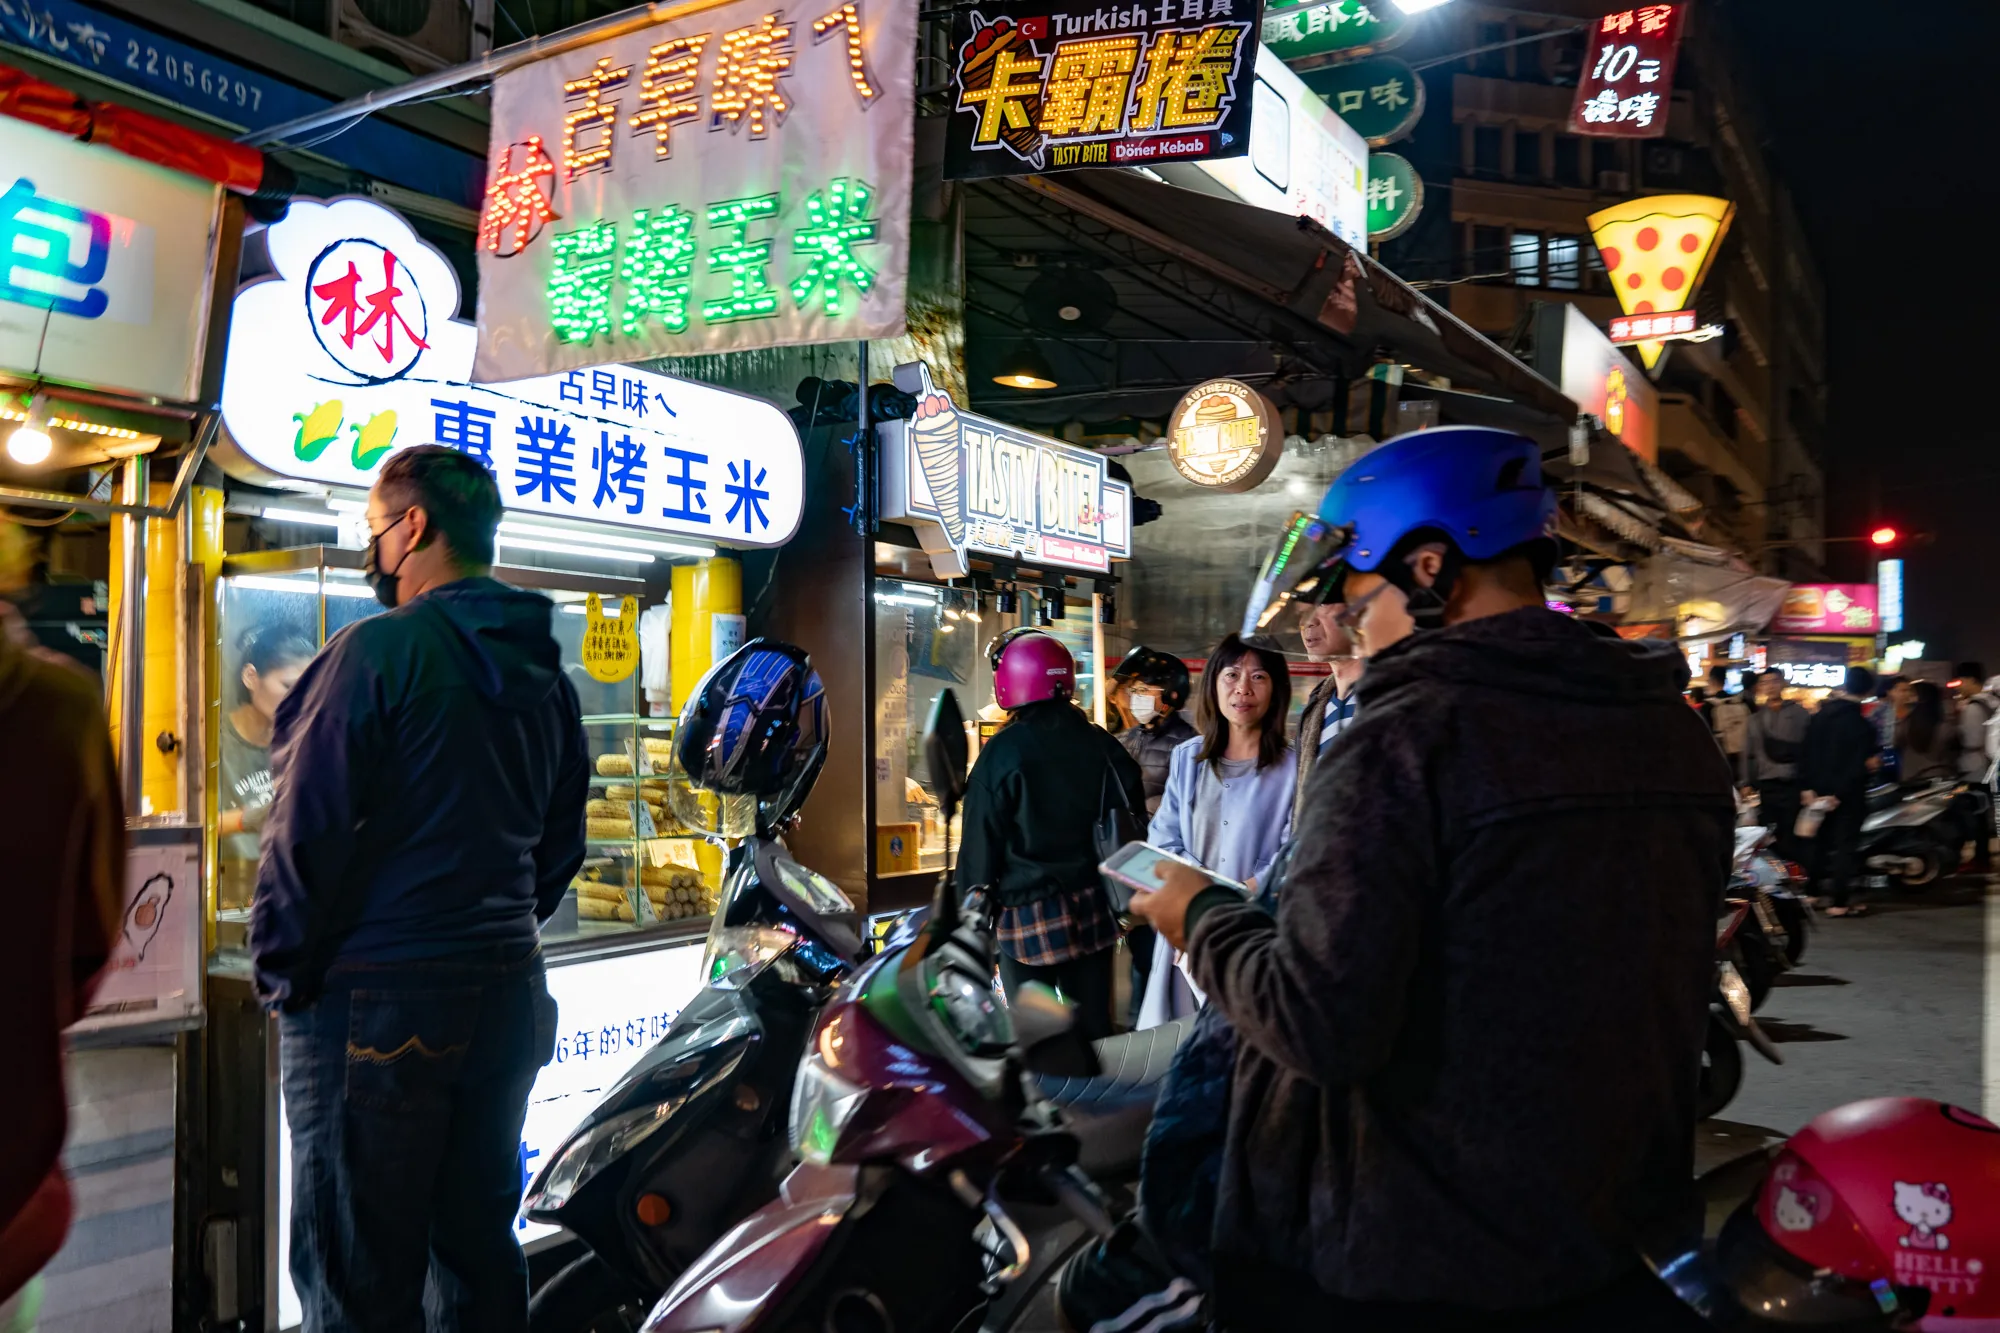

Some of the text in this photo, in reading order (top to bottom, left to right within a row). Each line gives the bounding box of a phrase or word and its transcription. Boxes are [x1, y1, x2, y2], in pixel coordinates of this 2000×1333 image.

[1052, 6, 1147, 36] Turkish
[126, 39, 262, 113] 22056297
[963, 28, 1238, 142] 卡霸捲
[1053, 145, 1081, 166] TASTY
[1115, 140, 1205, 159] Döner Kebab
[313, 250, 431, 364] 林
[1185, 382, 1249, 407] AUTHENTIC
[965, 429, 1037, 527] TASTY
[1221, 451, 1260, 484] CUISINE
[556, 1009, 682, 1064] 6年的好味
